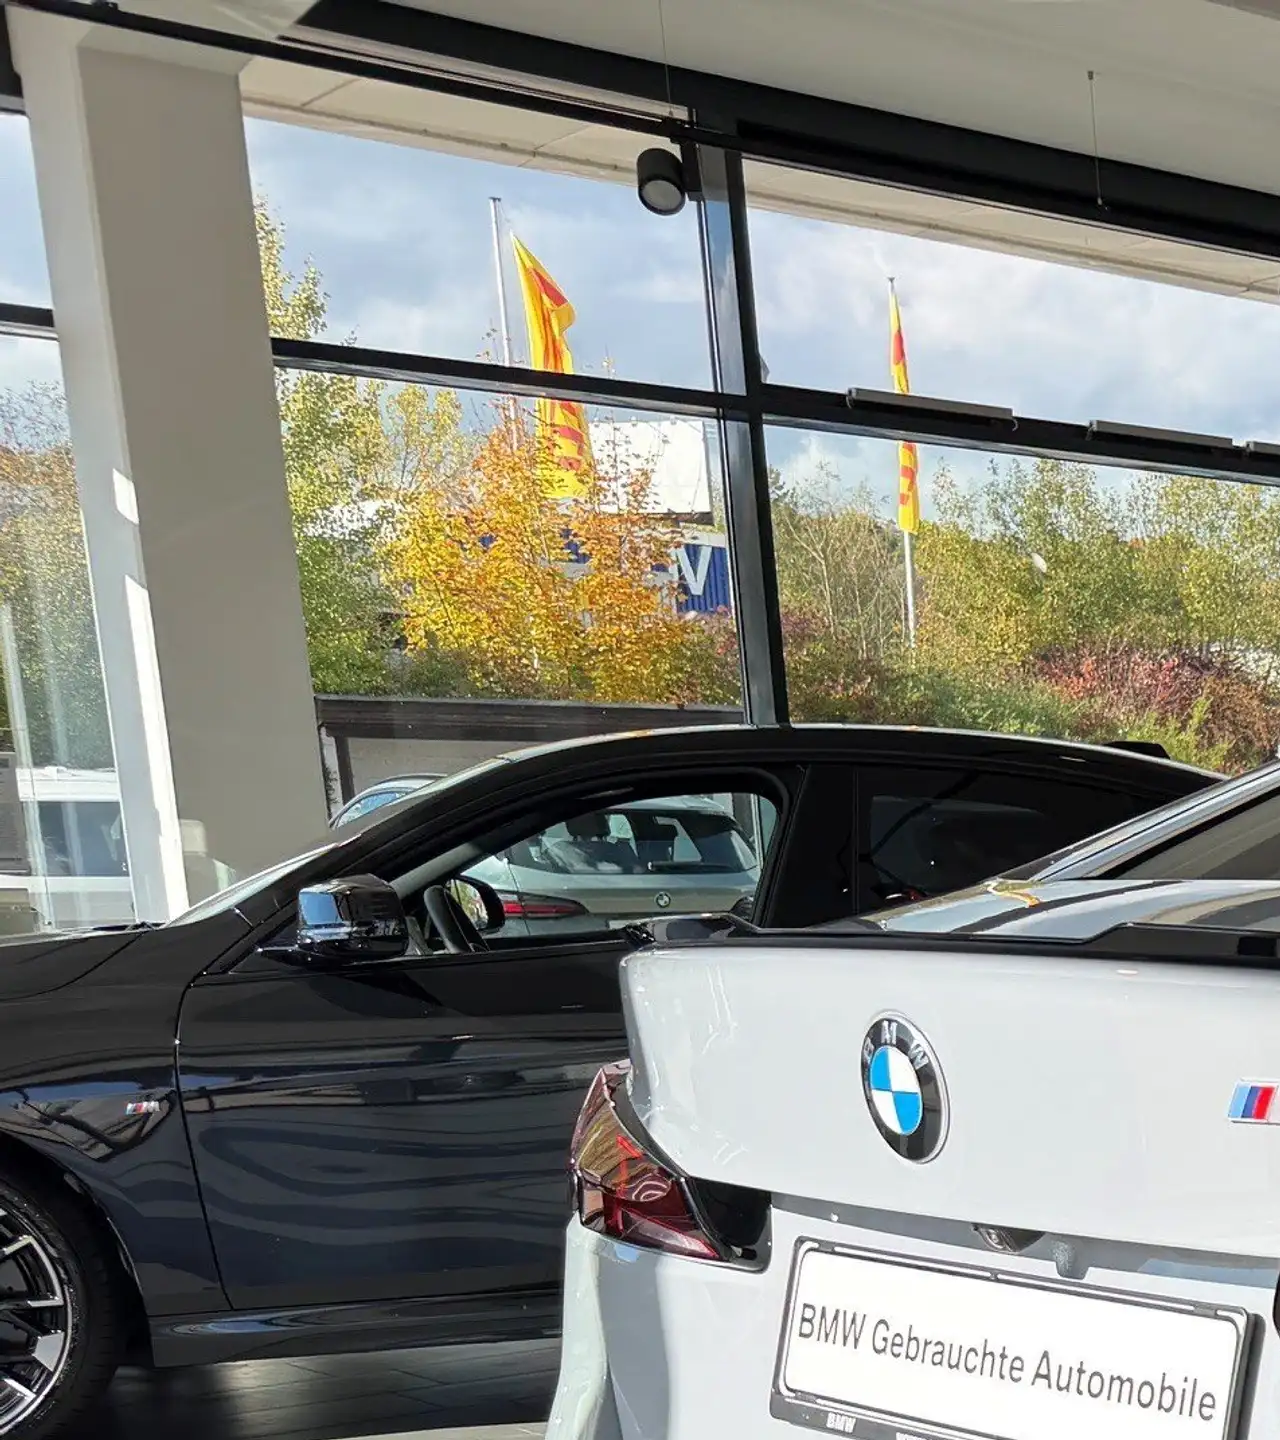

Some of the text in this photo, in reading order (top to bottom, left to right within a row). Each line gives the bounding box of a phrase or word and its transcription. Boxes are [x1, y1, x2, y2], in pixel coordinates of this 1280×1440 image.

[797, 1302, 1217, 1422] BMW Gebrauchte Automobile
[825, 1412, 857, 1434] BMW
